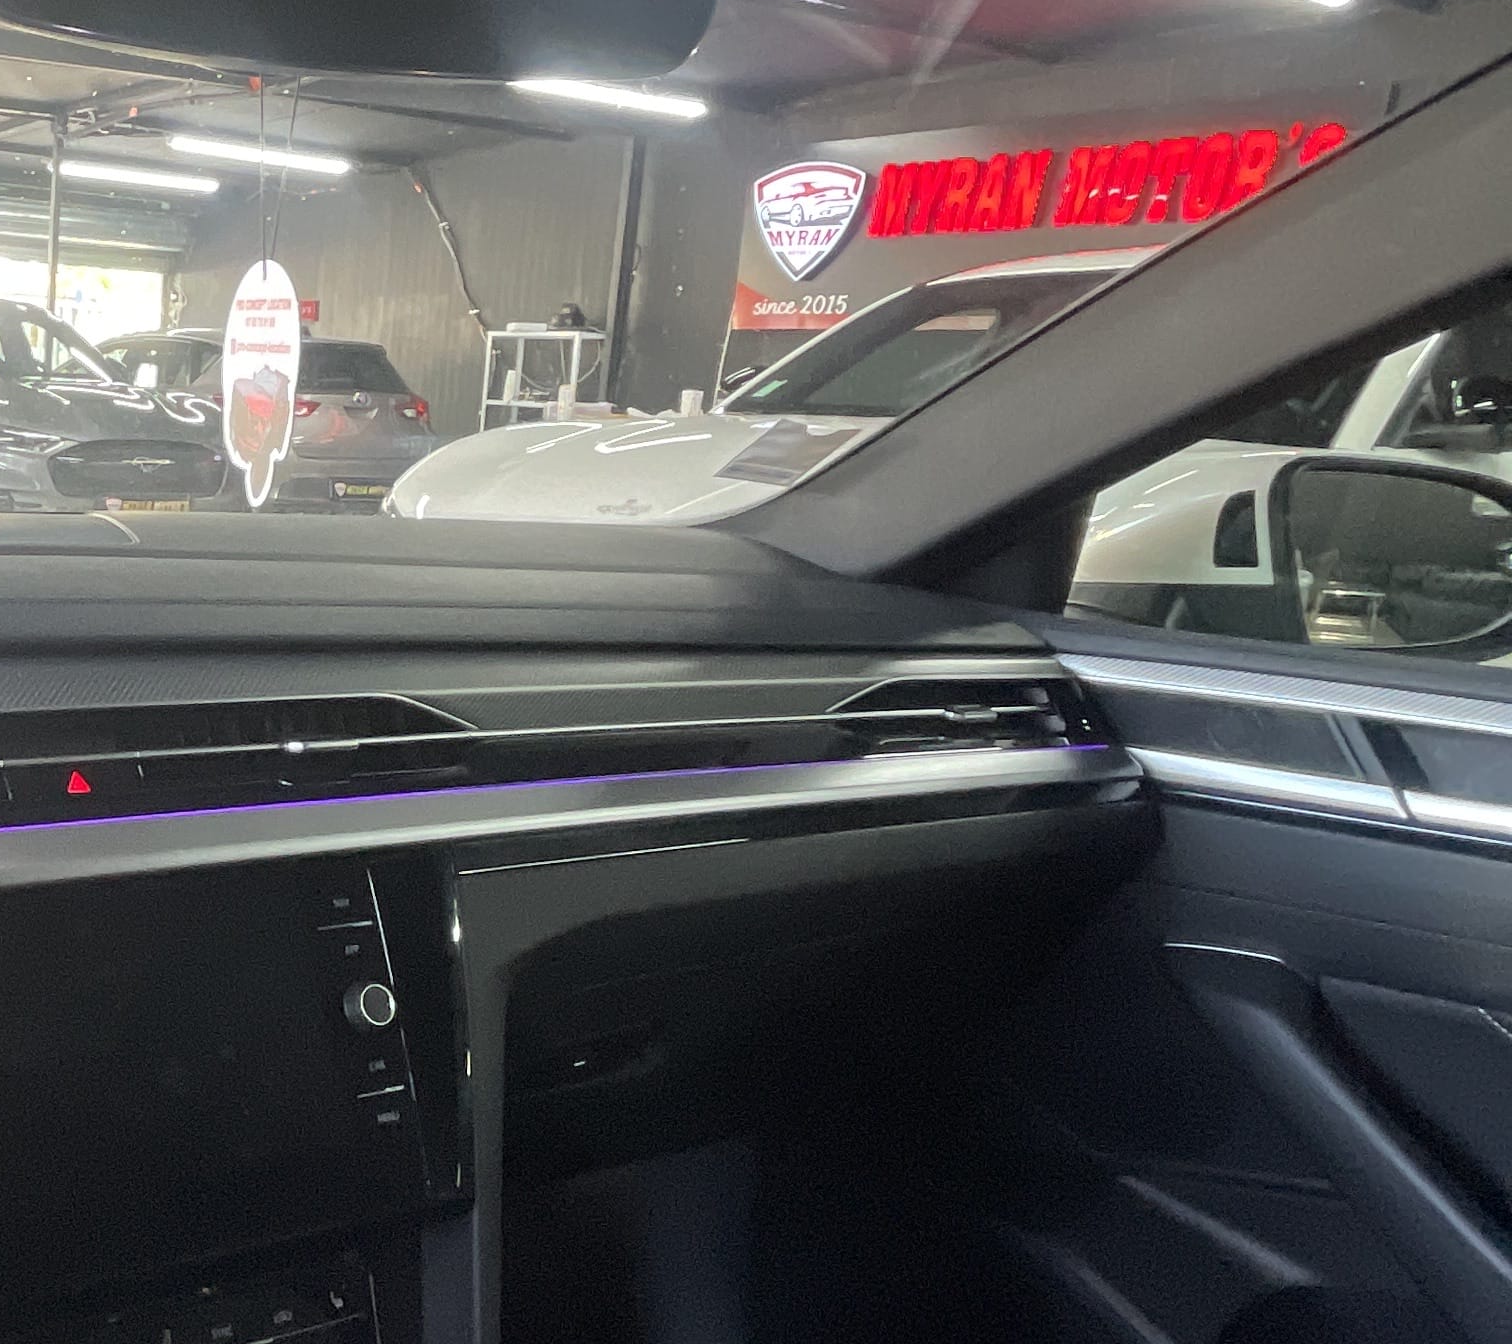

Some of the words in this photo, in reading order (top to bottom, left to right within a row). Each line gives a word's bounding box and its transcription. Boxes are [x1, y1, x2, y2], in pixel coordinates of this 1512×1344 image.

[867, 149, 1053, 237] MYRAN
[767, 228, 840, 247] MYRAN
[752, 298, 798, 316] since
[800, 294, 849, 315] 2015
